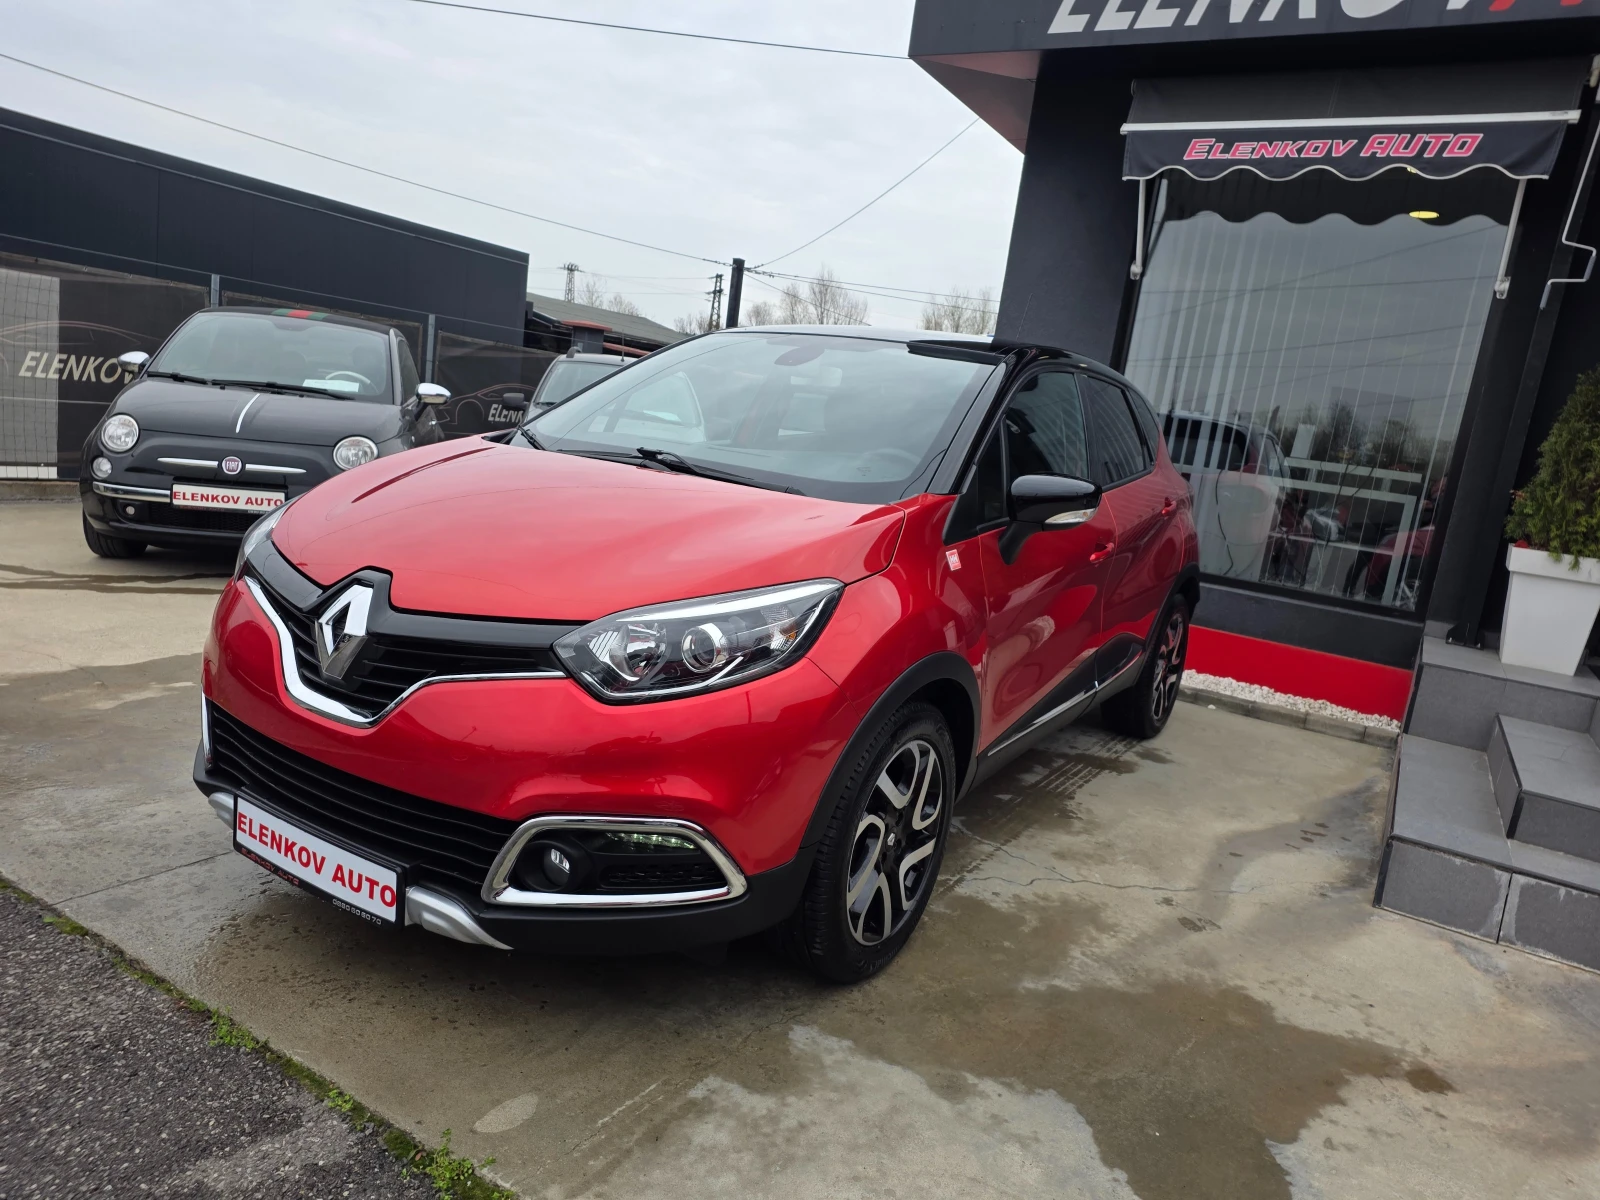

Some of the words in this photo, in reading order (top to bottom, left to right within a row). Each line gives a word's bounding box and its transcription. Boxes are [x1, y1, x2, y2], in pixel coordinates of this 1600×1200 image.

[1183, 138, 1358, 160] ELENKOV
[1360, 133, 1484, 158] AUTO
[226, 461, 239, 471] FIAT
[173, 491, 241, 505] ELENKOV
[245, 496, 284, 507] AUTO
[237, 811, 326, 875] ELENKOV
[331, 863, 397, 908] AUTO
